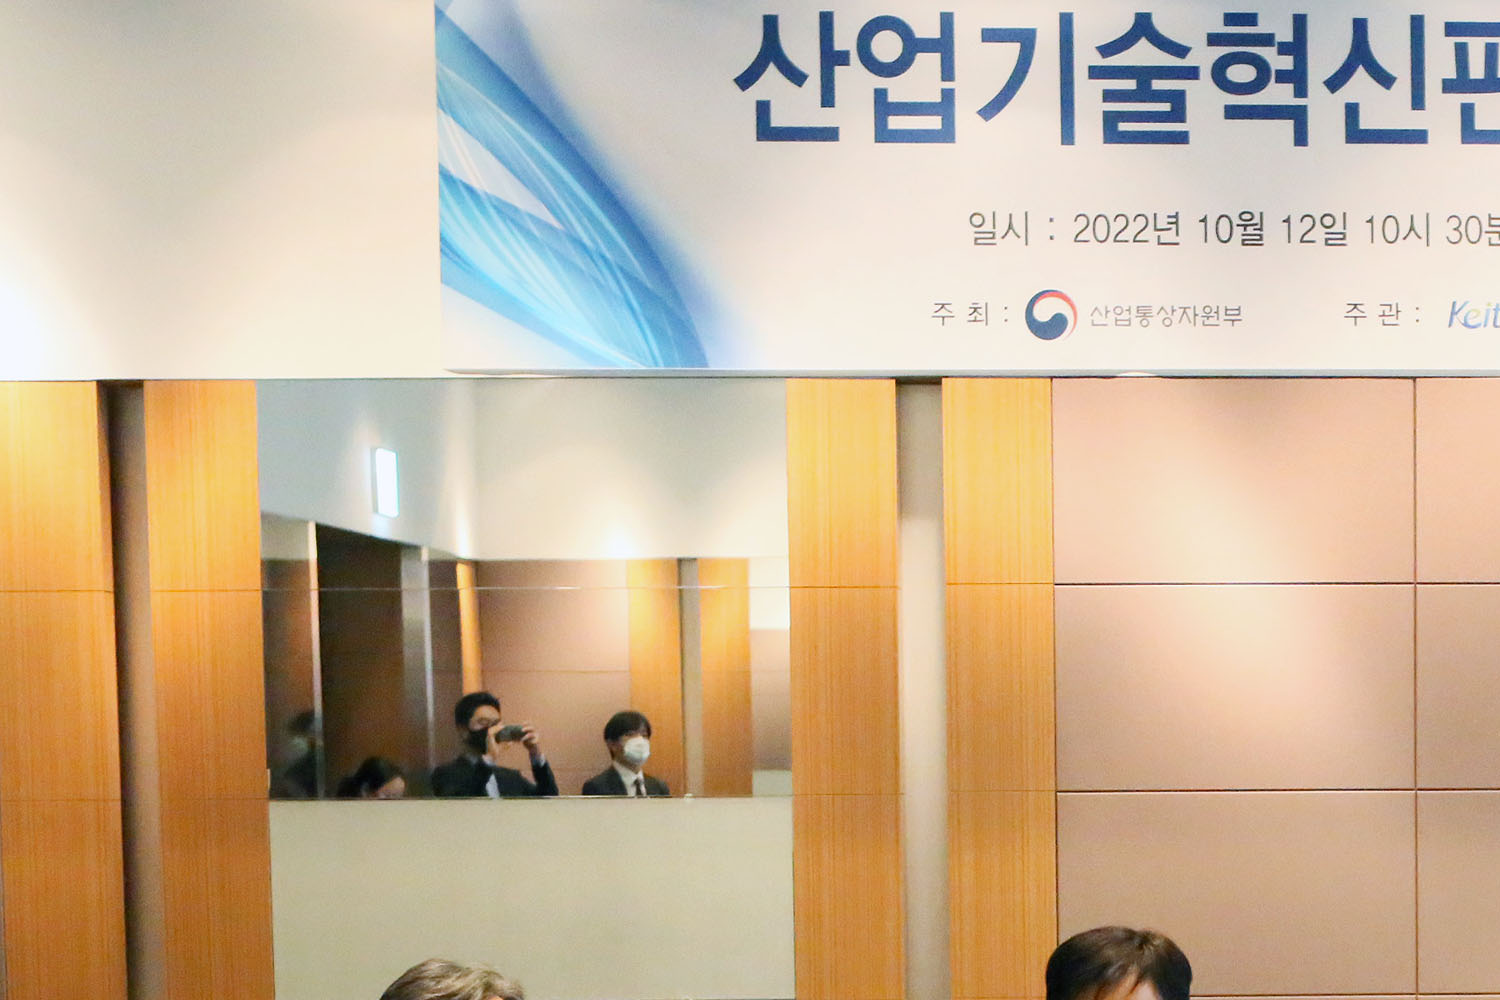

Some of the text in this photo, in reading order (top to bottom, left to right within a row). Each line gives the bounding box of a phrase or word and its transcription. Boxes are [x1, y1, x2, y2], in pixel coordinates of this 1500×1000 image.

[969, 210, 1029, 247] 일시
[1073, 211, 1181, 247] 2022년
[1198, 210, 1265, 247] 10월
[1281, 211, 1347, 247] 12일
[1365, 212, 1430, 248] 10시
[1090, 304, 1243, 329] 산업통상자원부
